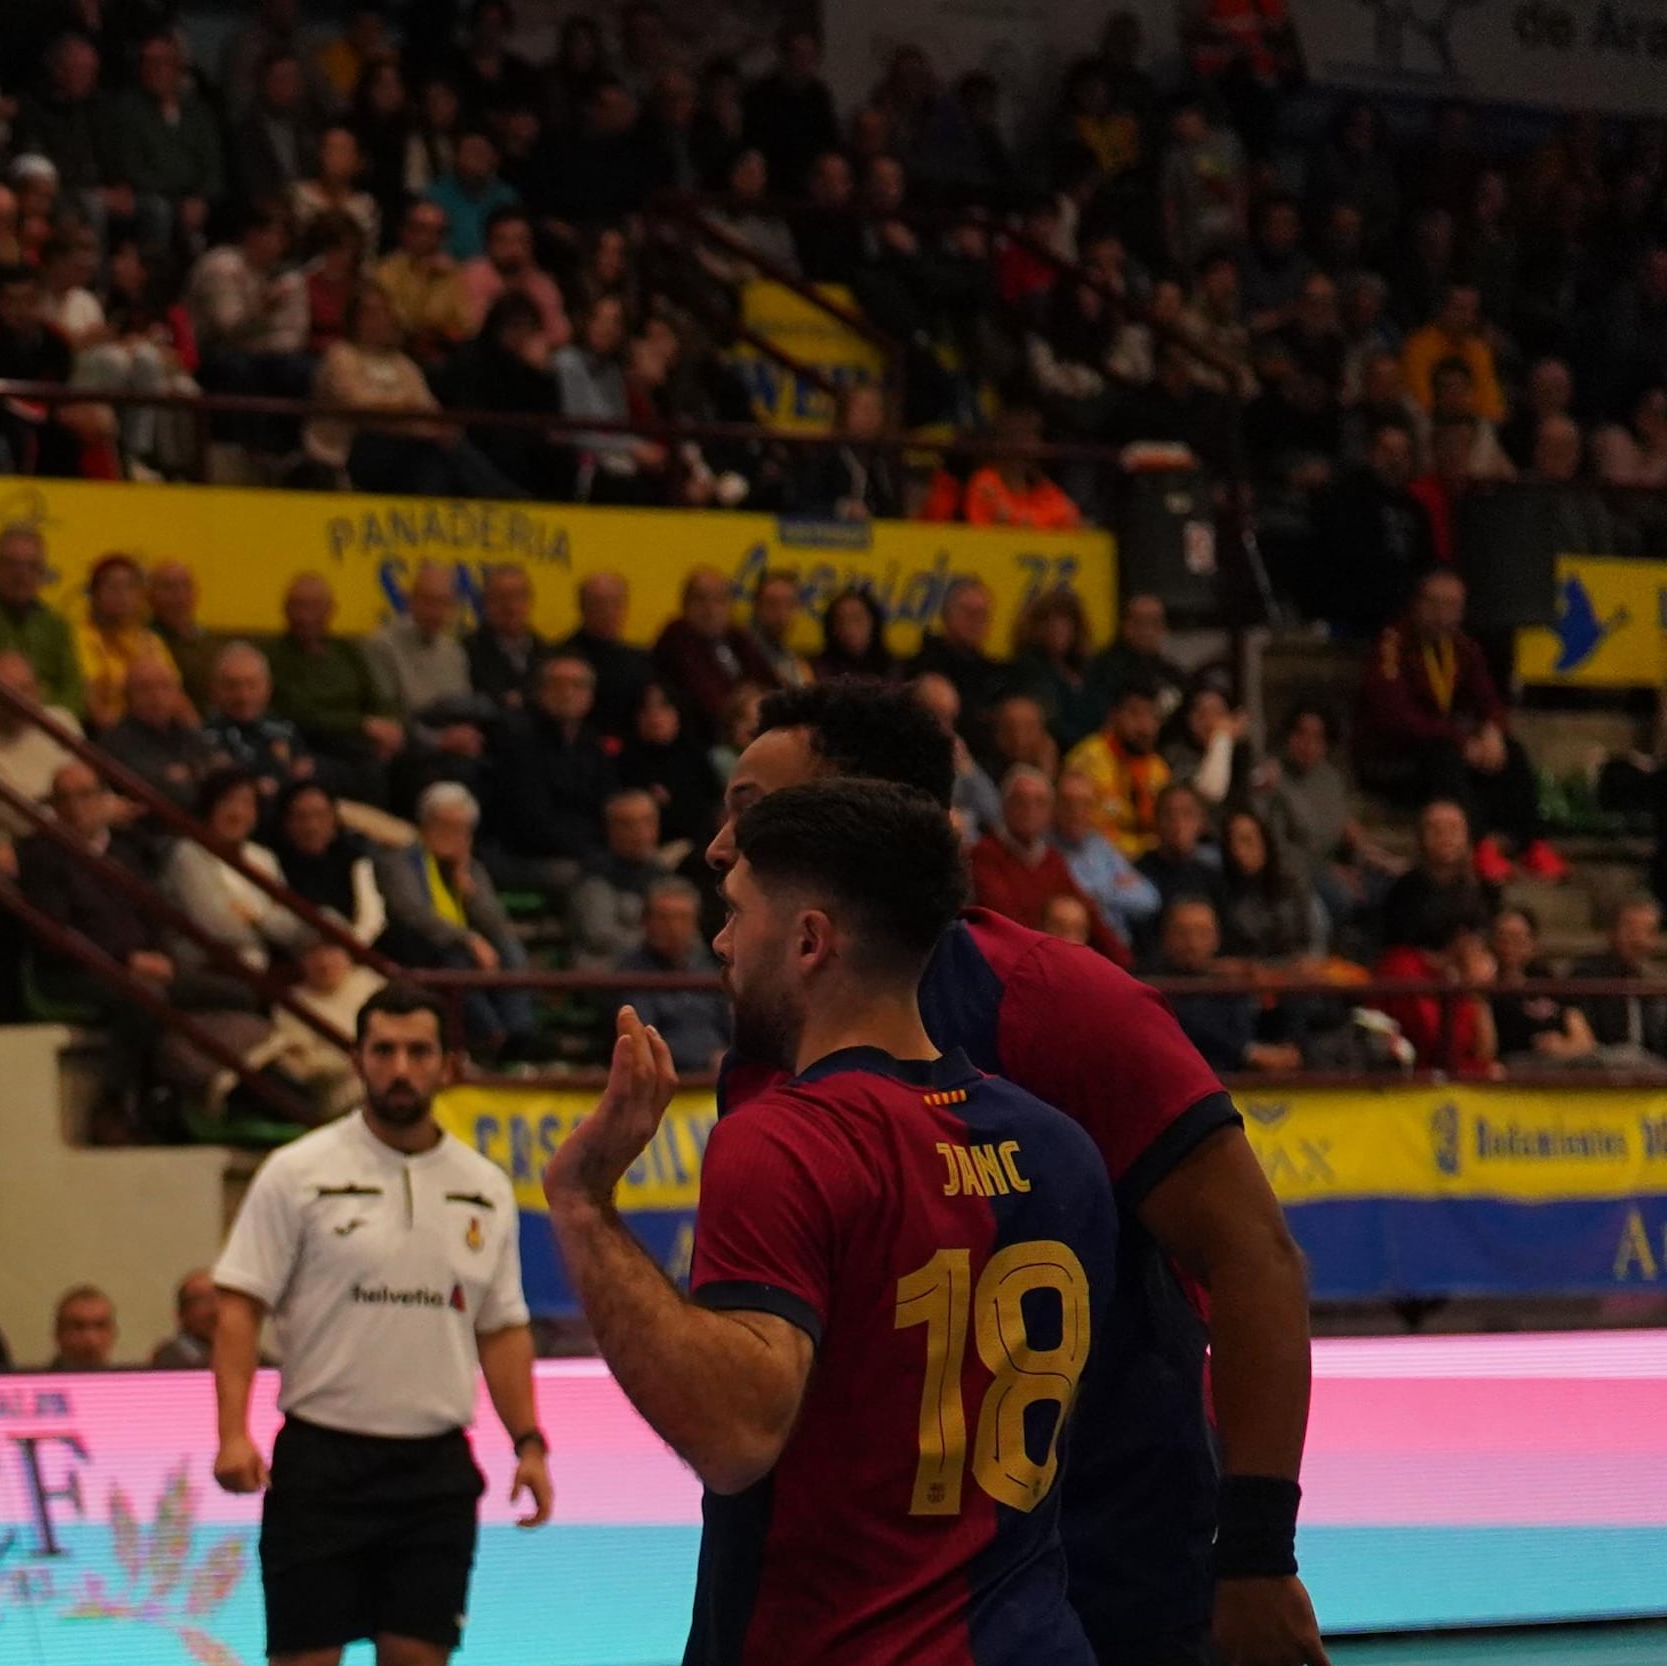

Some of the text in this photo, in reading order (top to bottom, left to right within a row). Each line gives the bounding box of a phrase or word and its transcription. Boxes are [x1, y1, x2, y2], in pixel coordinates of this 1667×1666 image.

[935, 1139, 1032, 1198] JANC
[350, 1283, 444, 1307] helvetia
[893, 1239, 1091, 1517] 18
